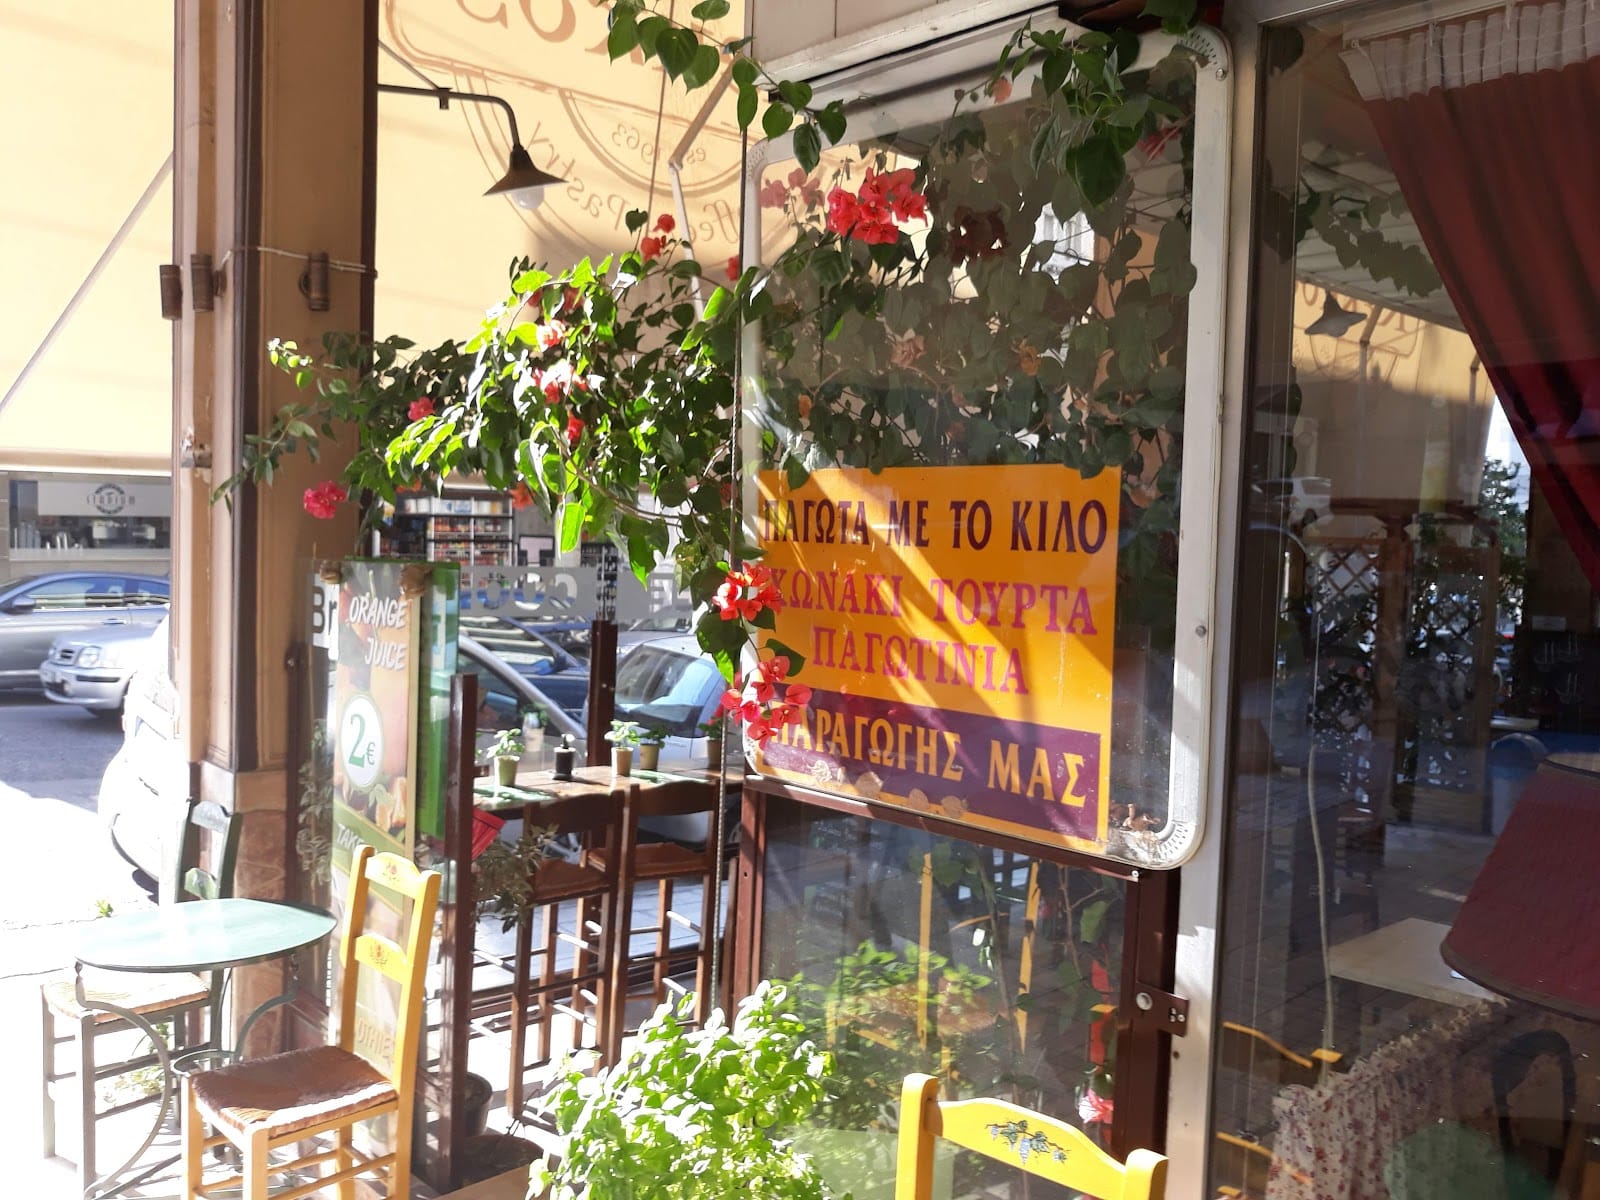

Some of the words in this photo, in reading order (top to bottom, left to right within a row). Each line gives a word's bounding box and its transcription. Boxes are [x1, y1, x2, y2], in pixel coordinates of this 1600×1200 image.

[763, 499, 870, 545] ΠΑΓΩΤΑ
[886, 499, 930, 547] ΜΕ
[949, 499, 993, 550] ΤΟ
[1009, 499, 1108, 554] ΚΙΛΟ
[349, 596, 408, 630] ORANGE
[929, 577, 1098, 636] ΤΟΥΡΤΑ
[364, 636, 407, 670] JUICE
[812, 626, 1029, 695] ΠΑΓΩΤΙΝΙΑ
[988, 739, 1087, 808] ΜΑΣ
